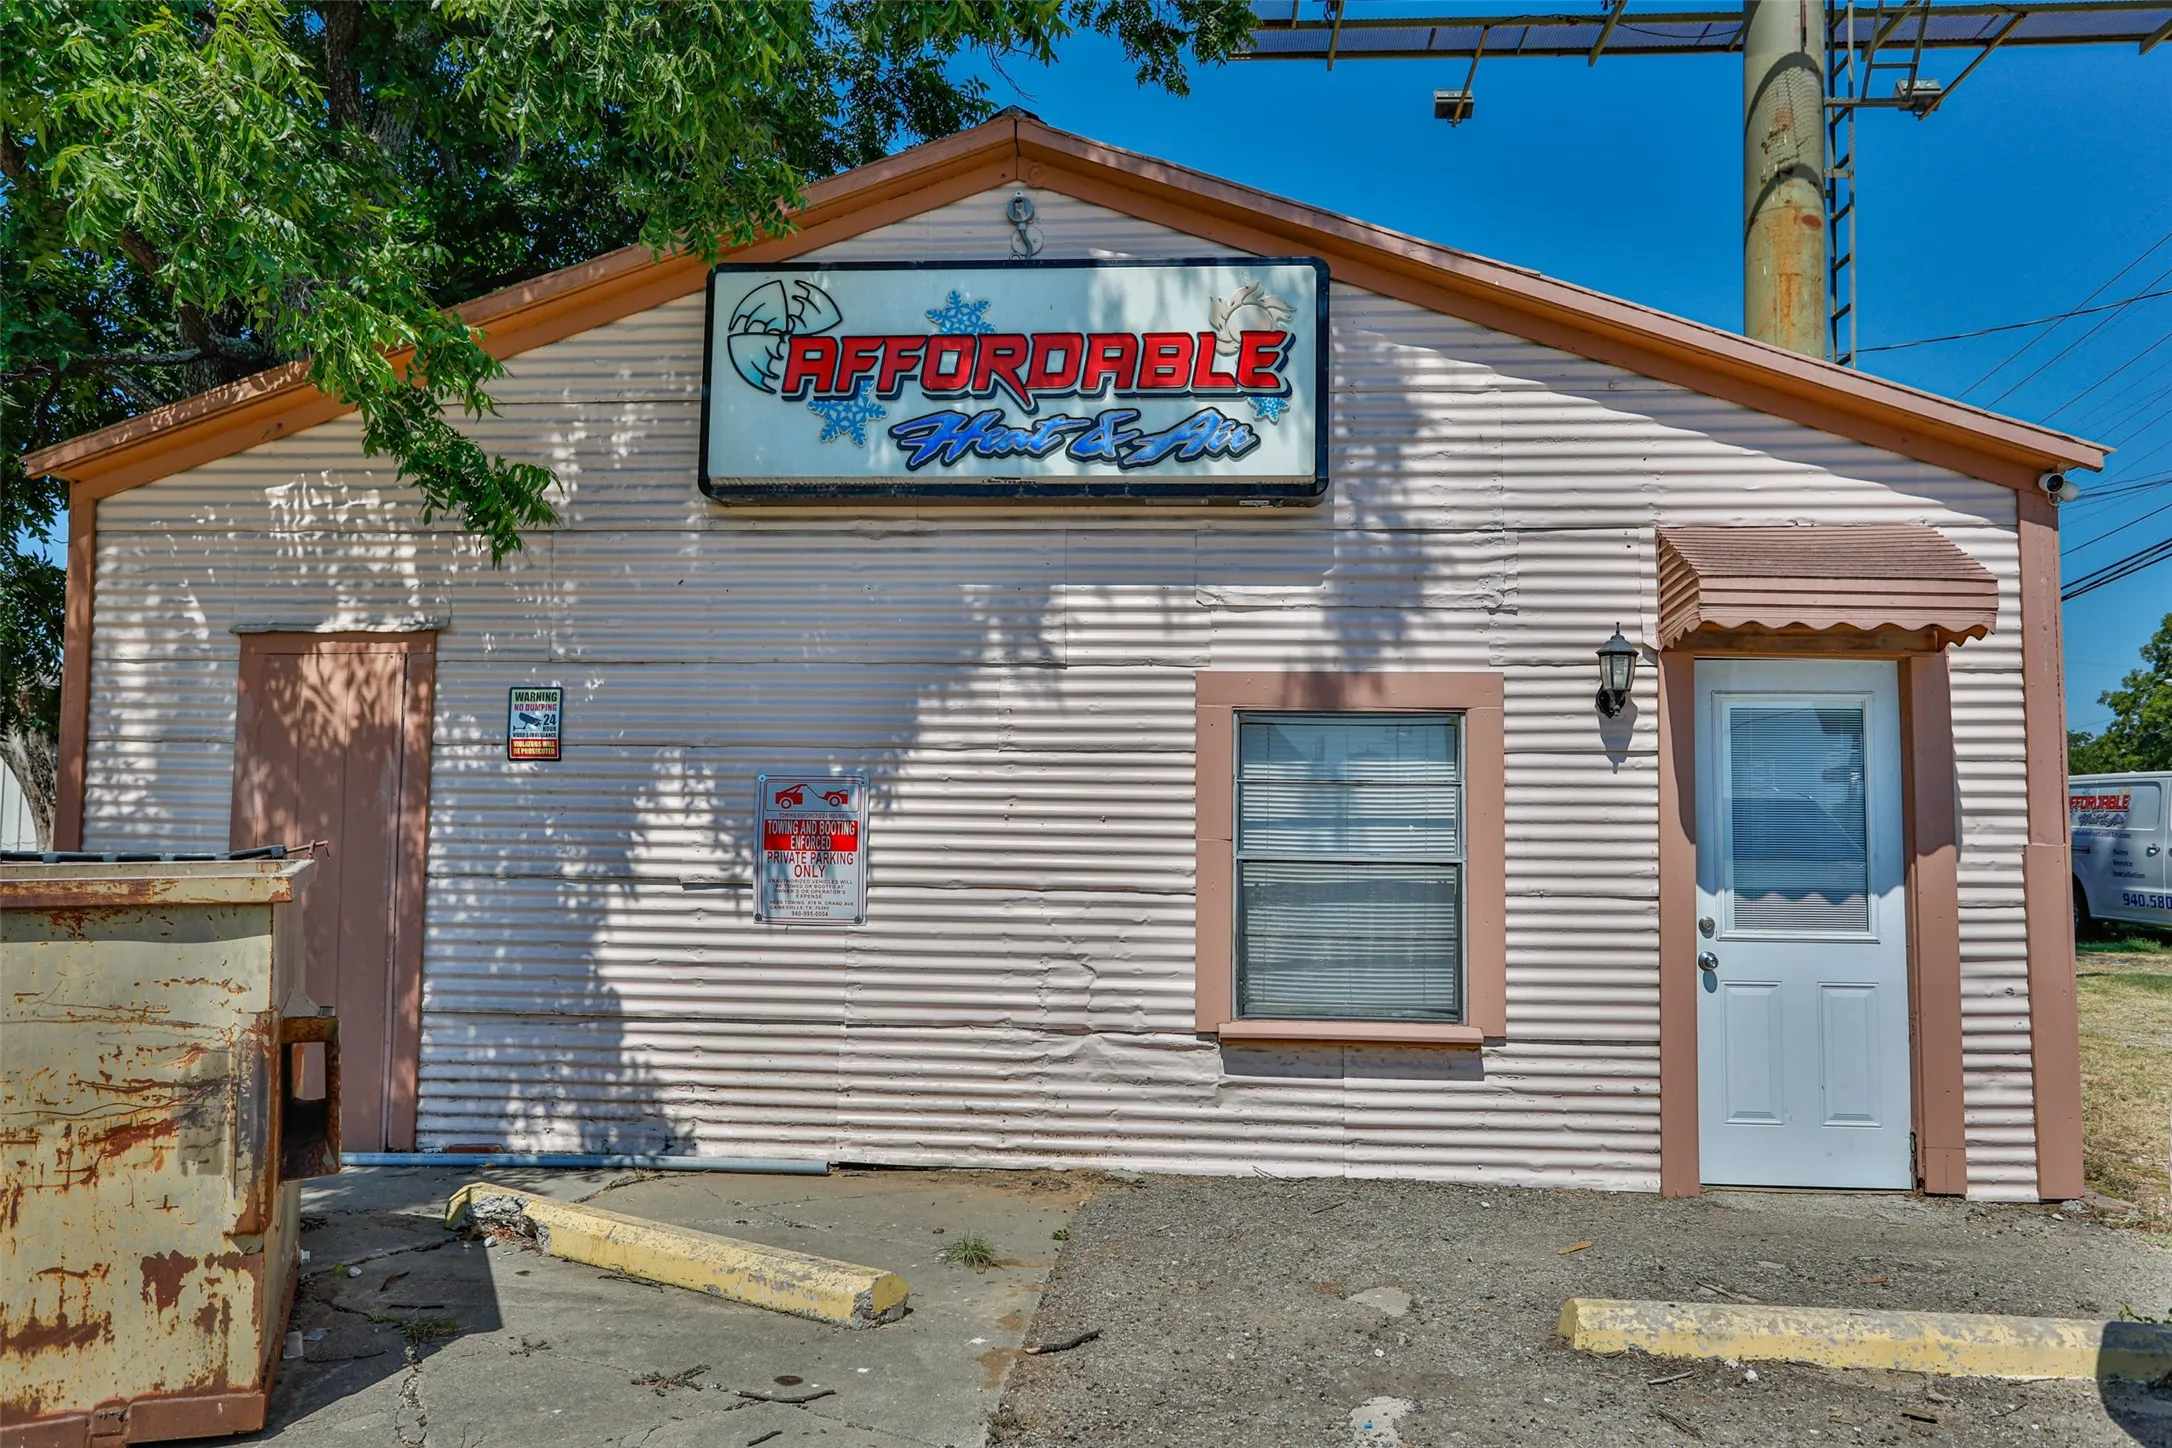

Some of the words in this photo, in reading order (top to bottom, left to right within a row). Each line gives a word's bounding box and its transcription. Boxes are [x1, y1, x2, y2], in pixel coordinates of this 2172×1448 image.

[781, 330, 1296, 413] AFFORDABLE
[890, 409, 1092, 471] Heat
[1066, 408, 1142, 461] &
[1117, 408, 1261, 471] Air
[514, 691, 558, 702] WARNING
[514, 703, 524, 711] NO
[525, 703, 557, 712] DUMPING
[543, 713, 557, 726] 24
[767, 820, 799, 835] TOWING
[800, 820, 817, 835] AND
[819, 821, 855, 836] BOOTING
[790, 835, 832, 850] ENFORCED
[767, 851, 807, 864] PRIVATE
[810, 852, 854, 865] PARKING
[2112, 848, 2128, 856] Sales
[2112, 859, 2133, 867] Service
[794, 864, 826, 878] ONLY
[2112, 870, 2146, 879] Installation
